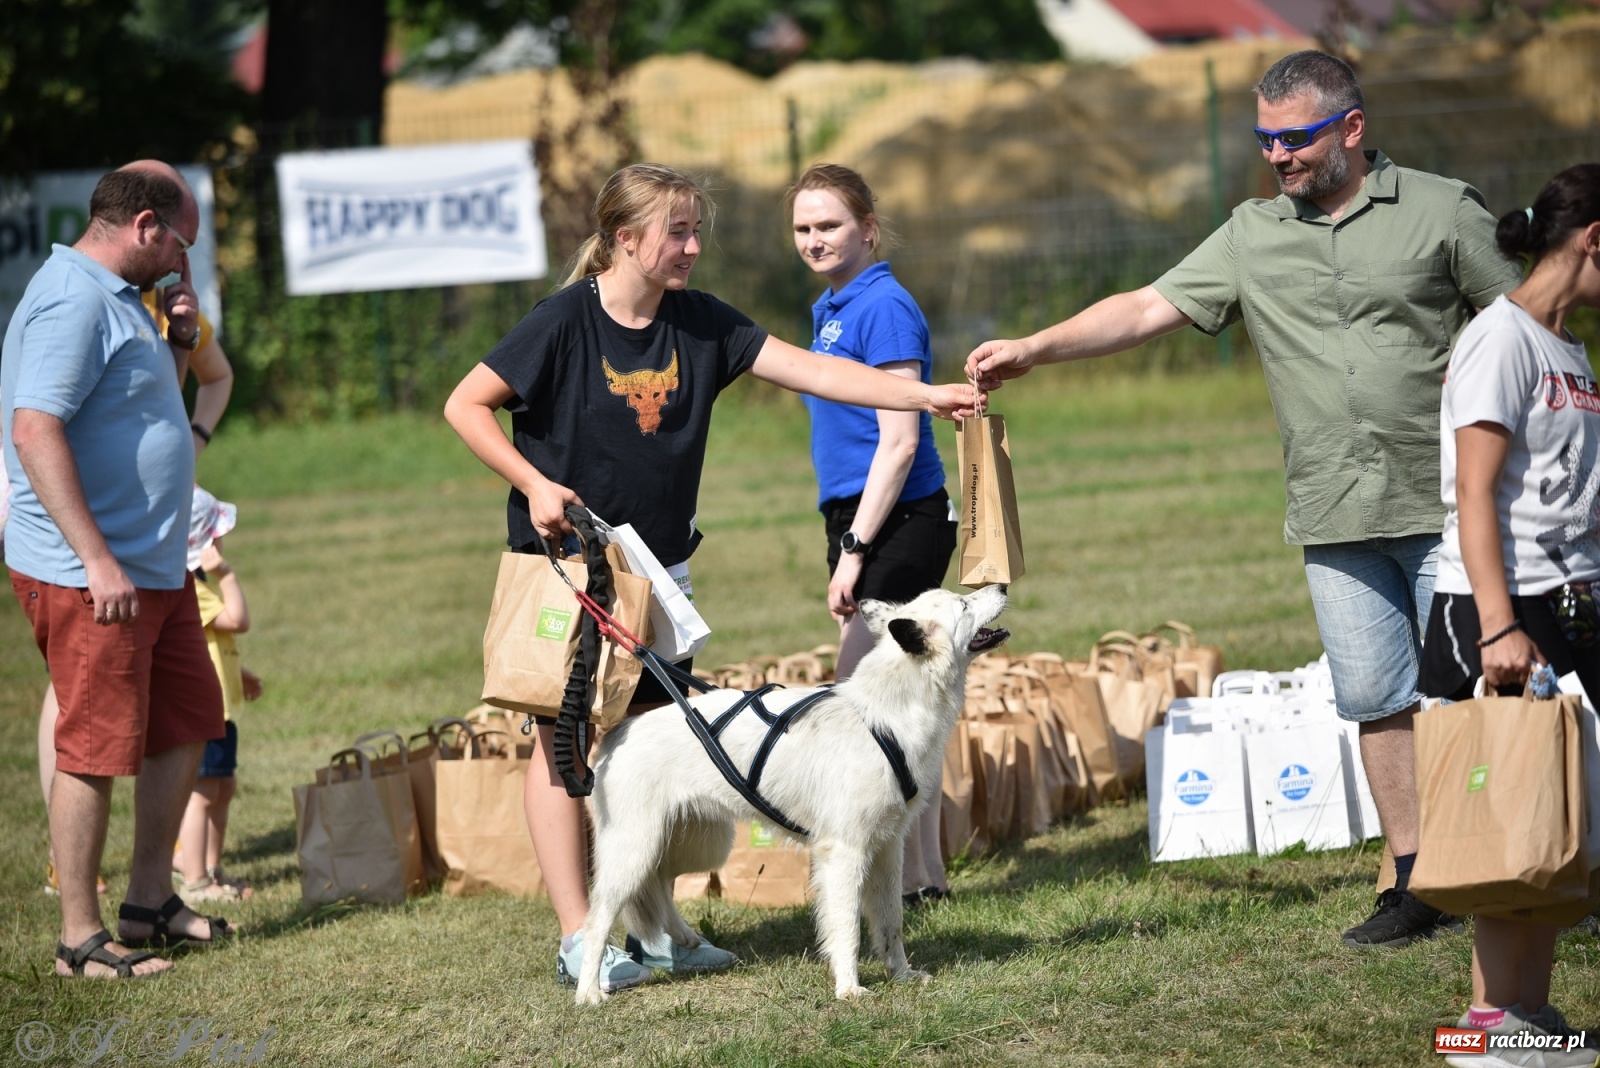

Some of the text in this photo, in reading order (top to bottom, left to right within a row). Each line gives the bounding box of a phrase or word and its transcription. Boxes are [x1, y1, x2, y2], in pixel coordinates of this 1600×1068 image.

[304, 183, 519, 249] HAPPY DOG
[970, 463, 979, 539] www.tropidog.pl
[1174, 782, 1212, 794] Farmina
[1277, 776, 1314, 790] Farmina
